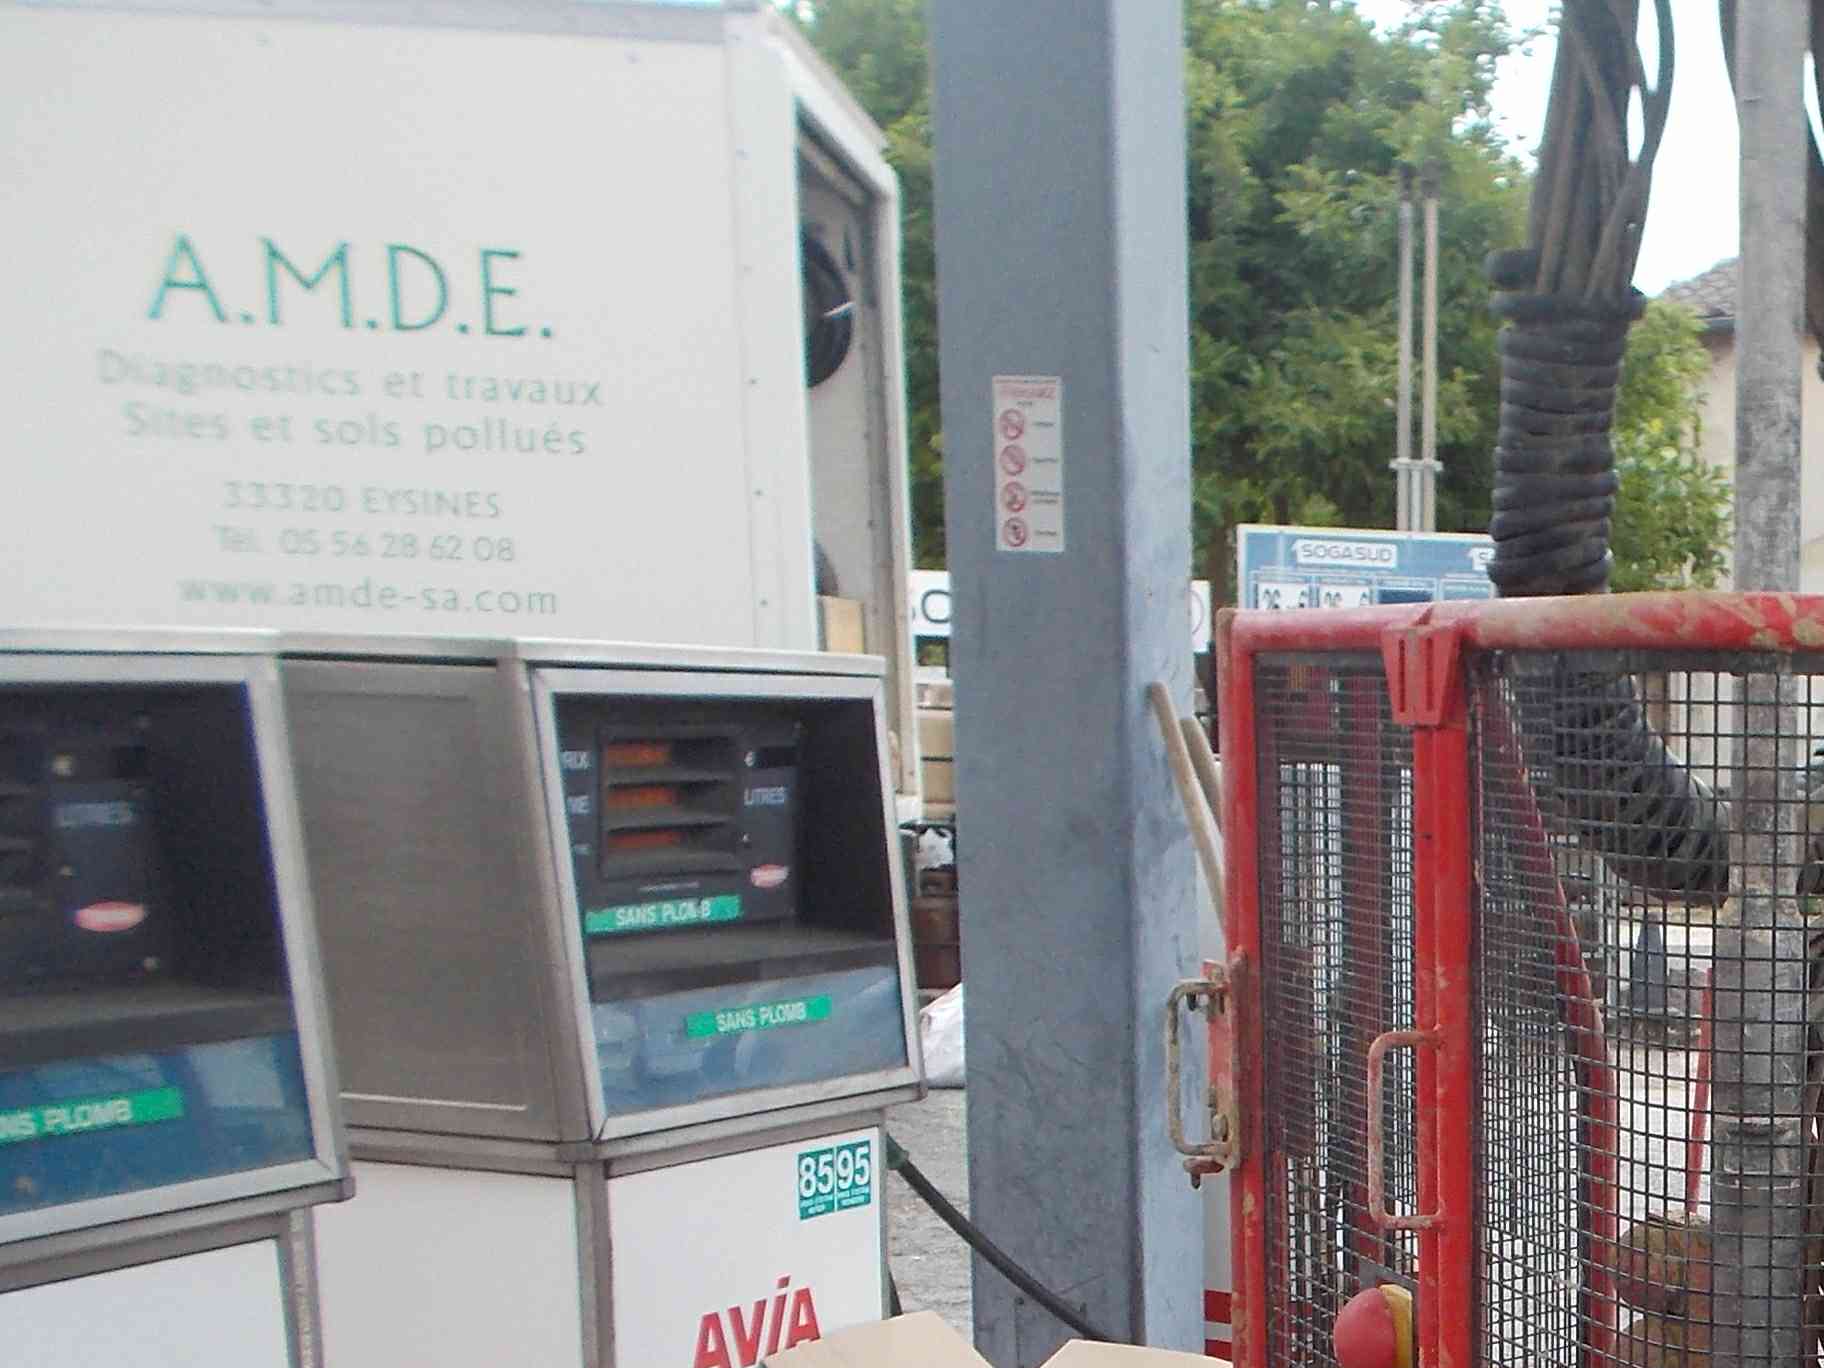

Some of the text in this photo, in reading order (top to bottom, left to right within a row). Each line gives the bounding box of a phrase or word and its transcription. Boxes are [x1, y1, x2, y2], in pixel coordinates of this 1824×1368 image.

[149, 232, 556, 339] A.M.D.E.
[98, 347, 605, 407] Diagnostics et travaux
[122, 399, 588, 456] Sites et sols pollués
[222, 480, 502, 518] 33320 EYSINES
[279, 529, 321, 557] 05
[332, 530, 371, 559] 56
[380, 531, 417, 559] 28
[430, 533, 465, 561] 62
[473, 534, 516, 562] 08
[176, 576, 560, 615] www.amde-sa.com
[616, 905, 656, 928] SANS
[716, 1001, 807, 1034] SANS PLOMB
[45, 1099, 132, 1134] PLOMB
[799, 1146, 871, 1198] 85 95
